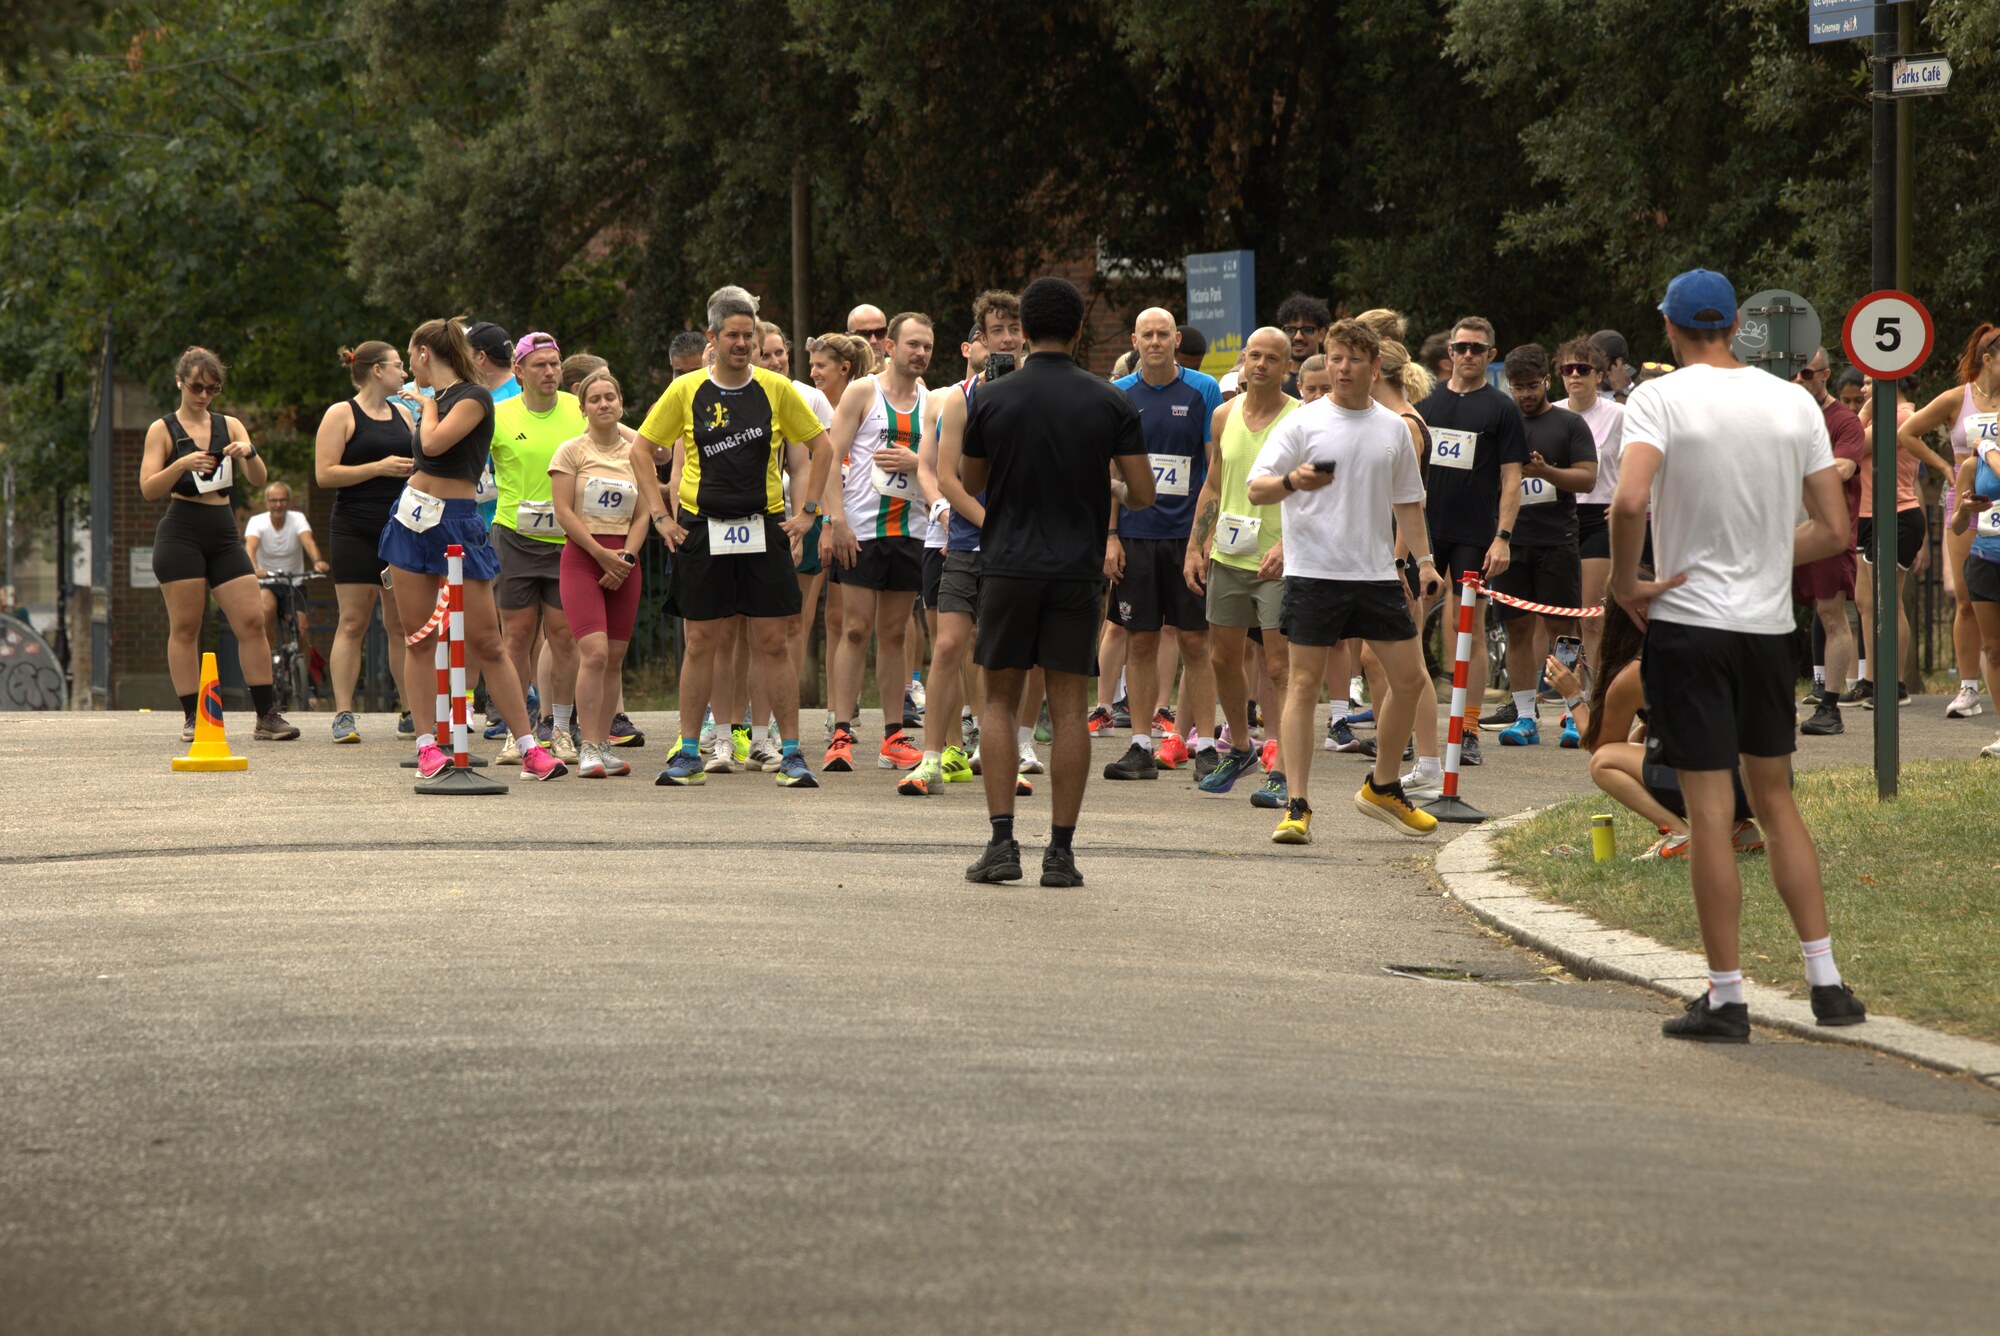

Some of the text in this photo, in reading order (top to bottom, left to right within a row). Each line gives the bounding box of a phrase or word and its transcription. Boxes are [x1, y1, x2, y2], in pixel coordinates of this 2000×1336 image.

[1813, 23, 1840, 34] The Greenway
[1922, 66, 1940, 82] Café
[1190, 285, 1222, 303] Victoria Park
[1874, 317, 1901, 352] 5
[1977, 422, 1999, 438] 76
[703, 427, 763, 458] Run&Frite
[1437, 441, 1460, 459] 64
[885, 472, 908, 489] 75
[1153, 467, 1177, 485] 74
[1521, 478, 1543, 496] 10
[597, 490, 623, 508] 49
[411, 505, 422, 522] 4
[531, 512, 554, 528] 71
[724, 526, 750, 544] 40
[1229, 527, 1239, 544] 7
